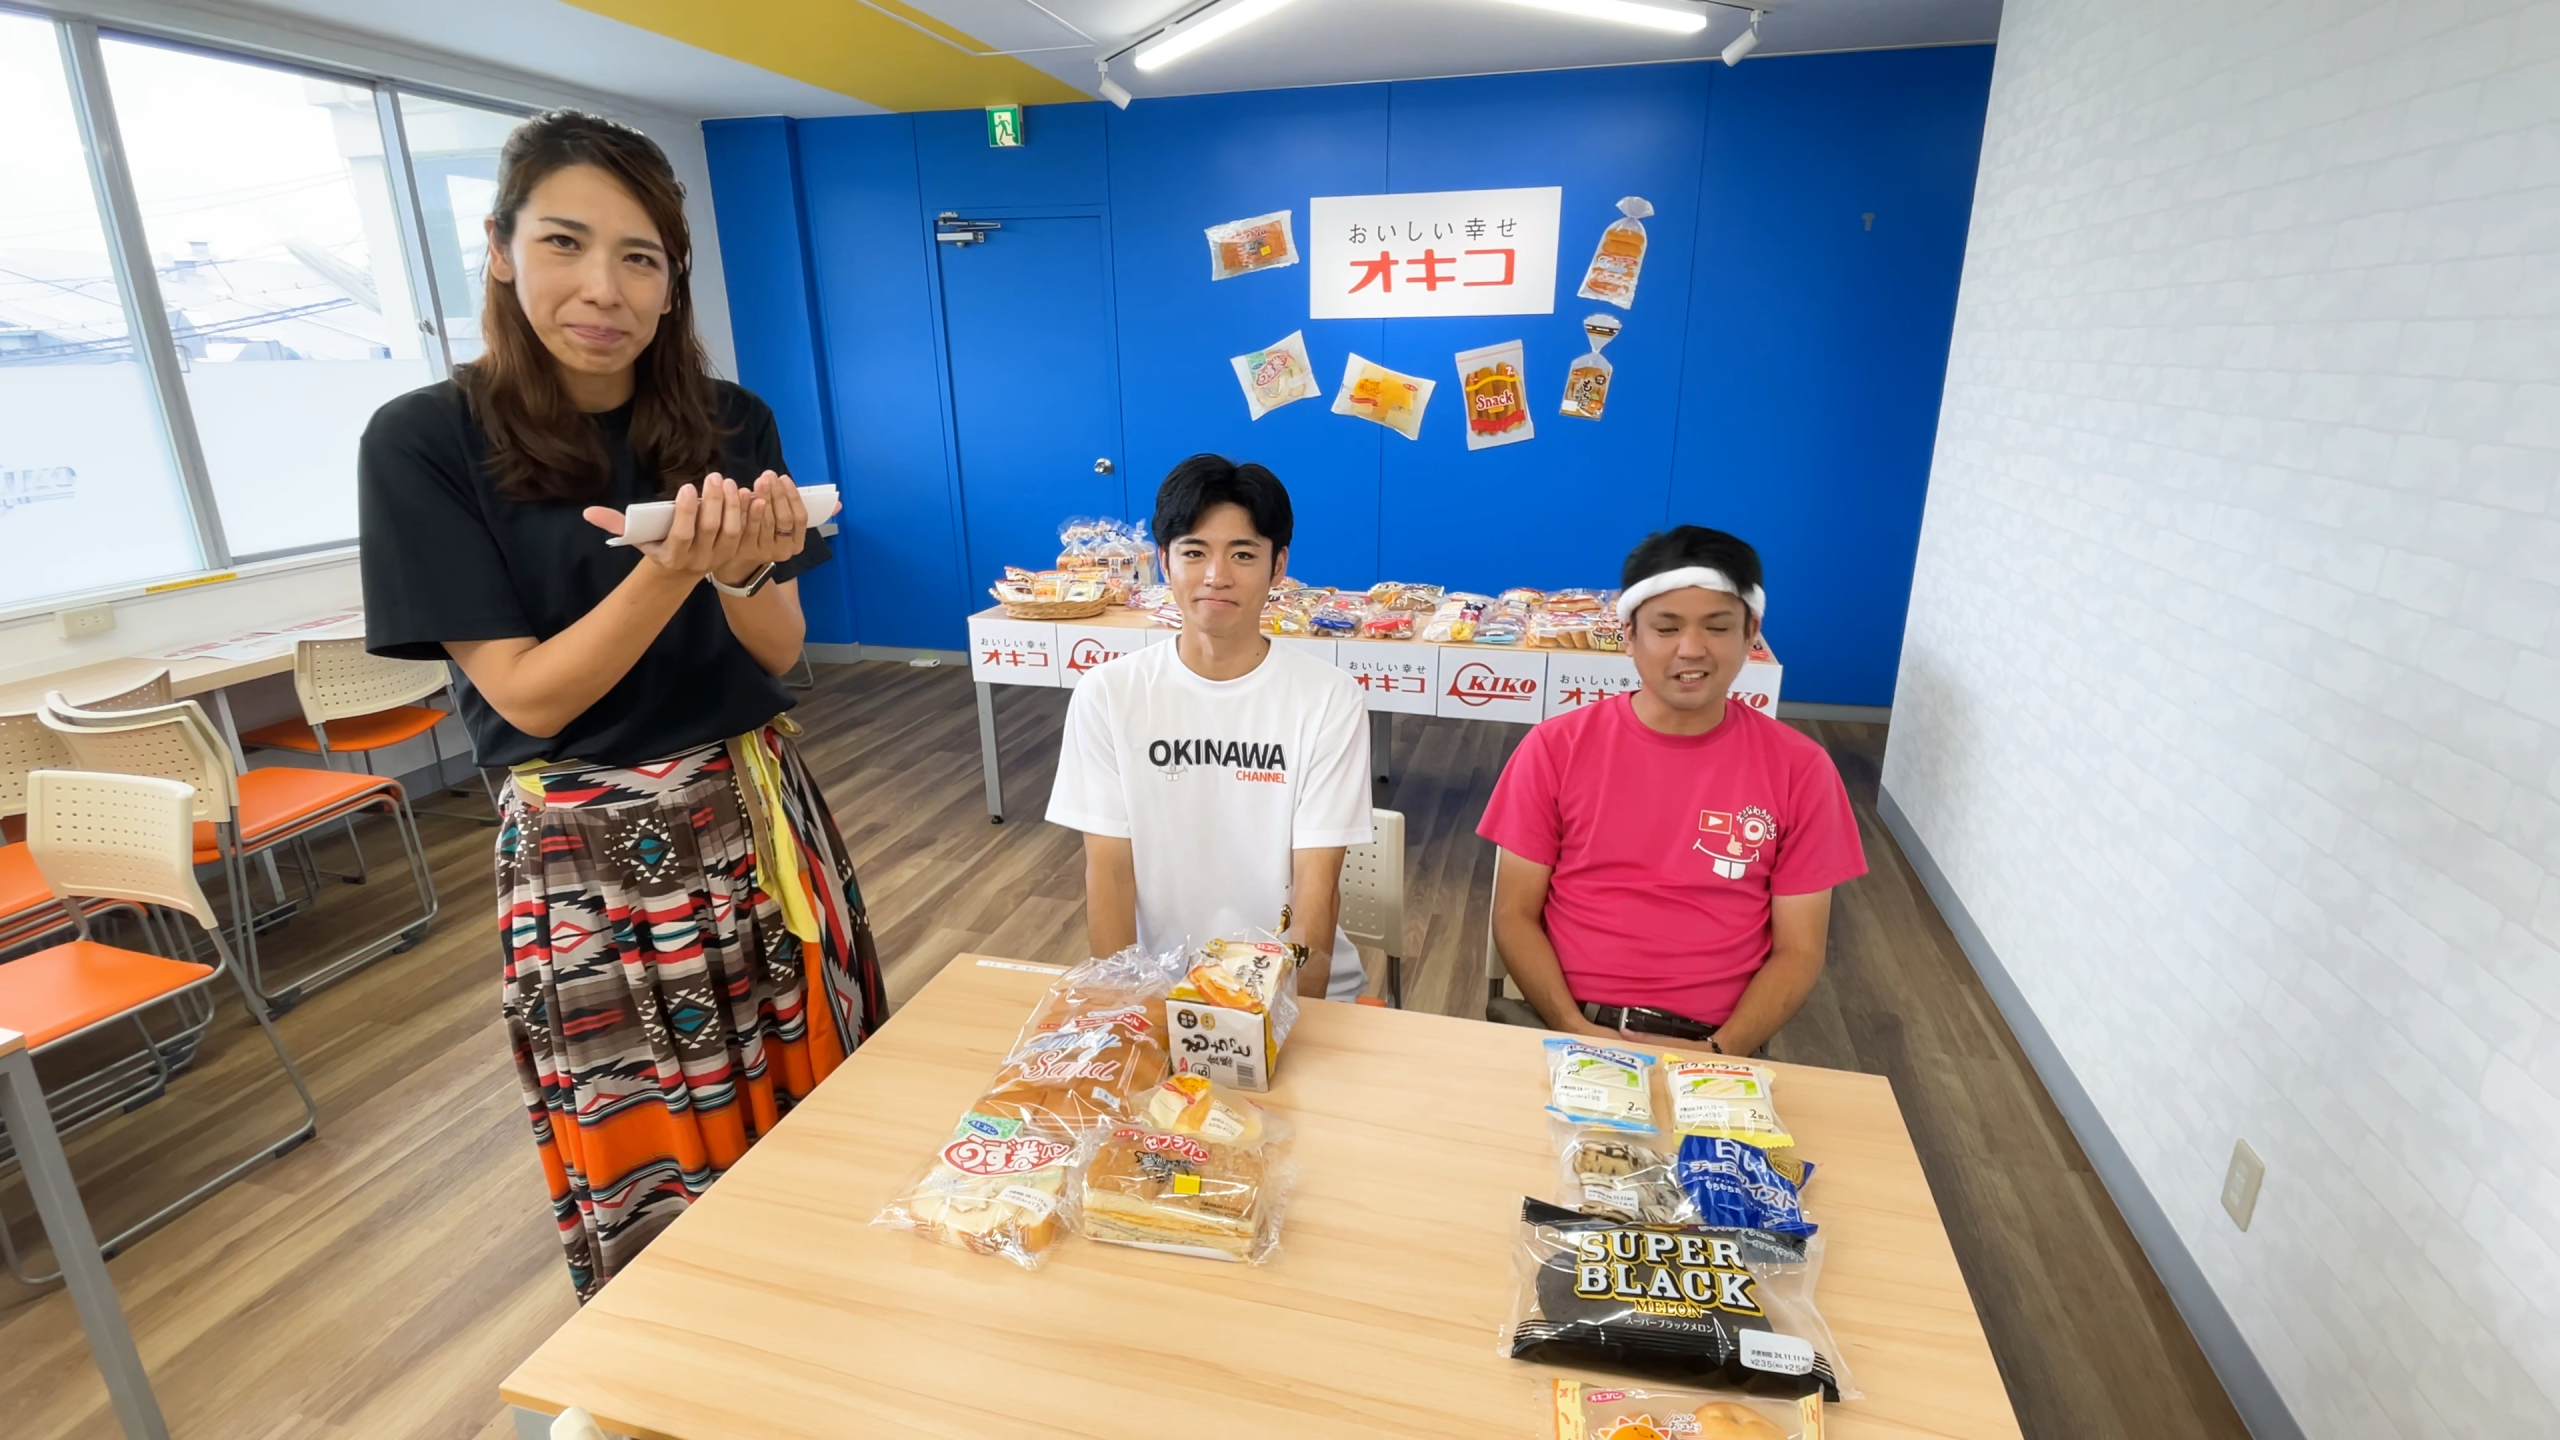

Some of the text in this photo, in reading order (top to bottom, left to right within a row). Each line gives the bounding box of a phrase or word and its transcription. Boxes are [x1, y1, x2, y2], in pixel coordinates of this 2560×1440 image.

[1348, 217, 1518, 245] おいしい幸せ
[1348, 248, 1516, 294] オキコ
[1476, 390, 1514, 410] Snack
[980, 637, 1048, 650] おいしい幸せ
[981, 649, 1049, 667] オキコ
[1349, 660, 1427, 675] おいしい幸せ
[1149, 738, 1288, 771] OKINAWA
[1235, 770, 1287, 784] CHANNEL
[1181, 1033, 1251, 1058] もちっと
[1020, 1050, 1121, 1082] Sand
[1578, 1229, 1746, 1269] SUPER
[1575, 1262, 1760, 1312] BLACK
[1633, 1299, 1704, 1319] MELON
[1624, 1316, 1715, 1335] スーパーブラックメロン
